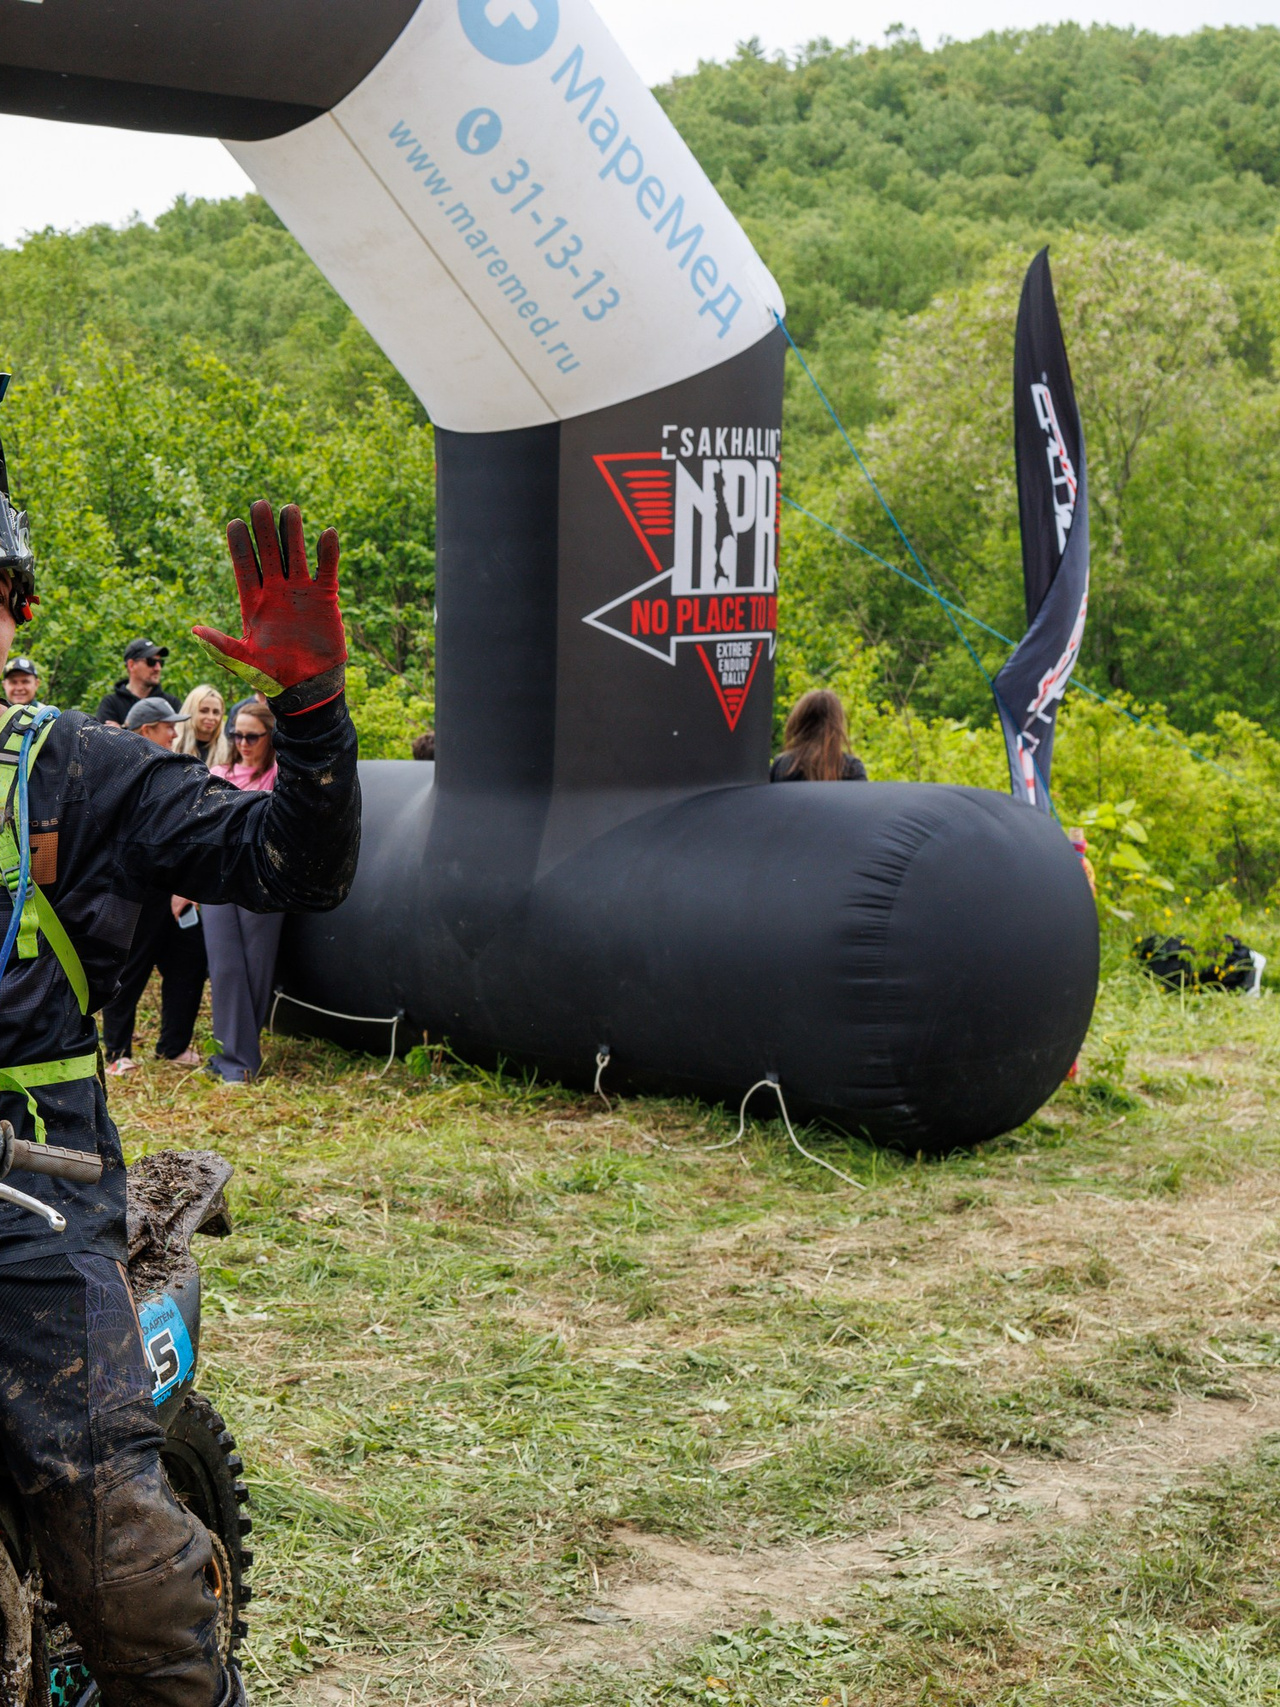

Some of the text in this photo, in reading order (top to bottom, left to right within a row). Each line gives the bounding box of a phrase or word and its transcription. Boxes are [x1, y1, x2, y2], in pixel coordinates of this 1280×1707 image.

[550, 44, 743, 338] МареМед
[389, 120, 580, 374] www.maremed.ru
[490, 158, 620, 323] 31-13-13
[631, 600, 669, 635] NO
[676, 596, 745, 634] PLACE
[749, 595, 766, 631] TO
[716, 641, 752, 658] EXTREME
[721, 671, 746, 685] RALLY
[145, 1327, 180, 1394] 5
